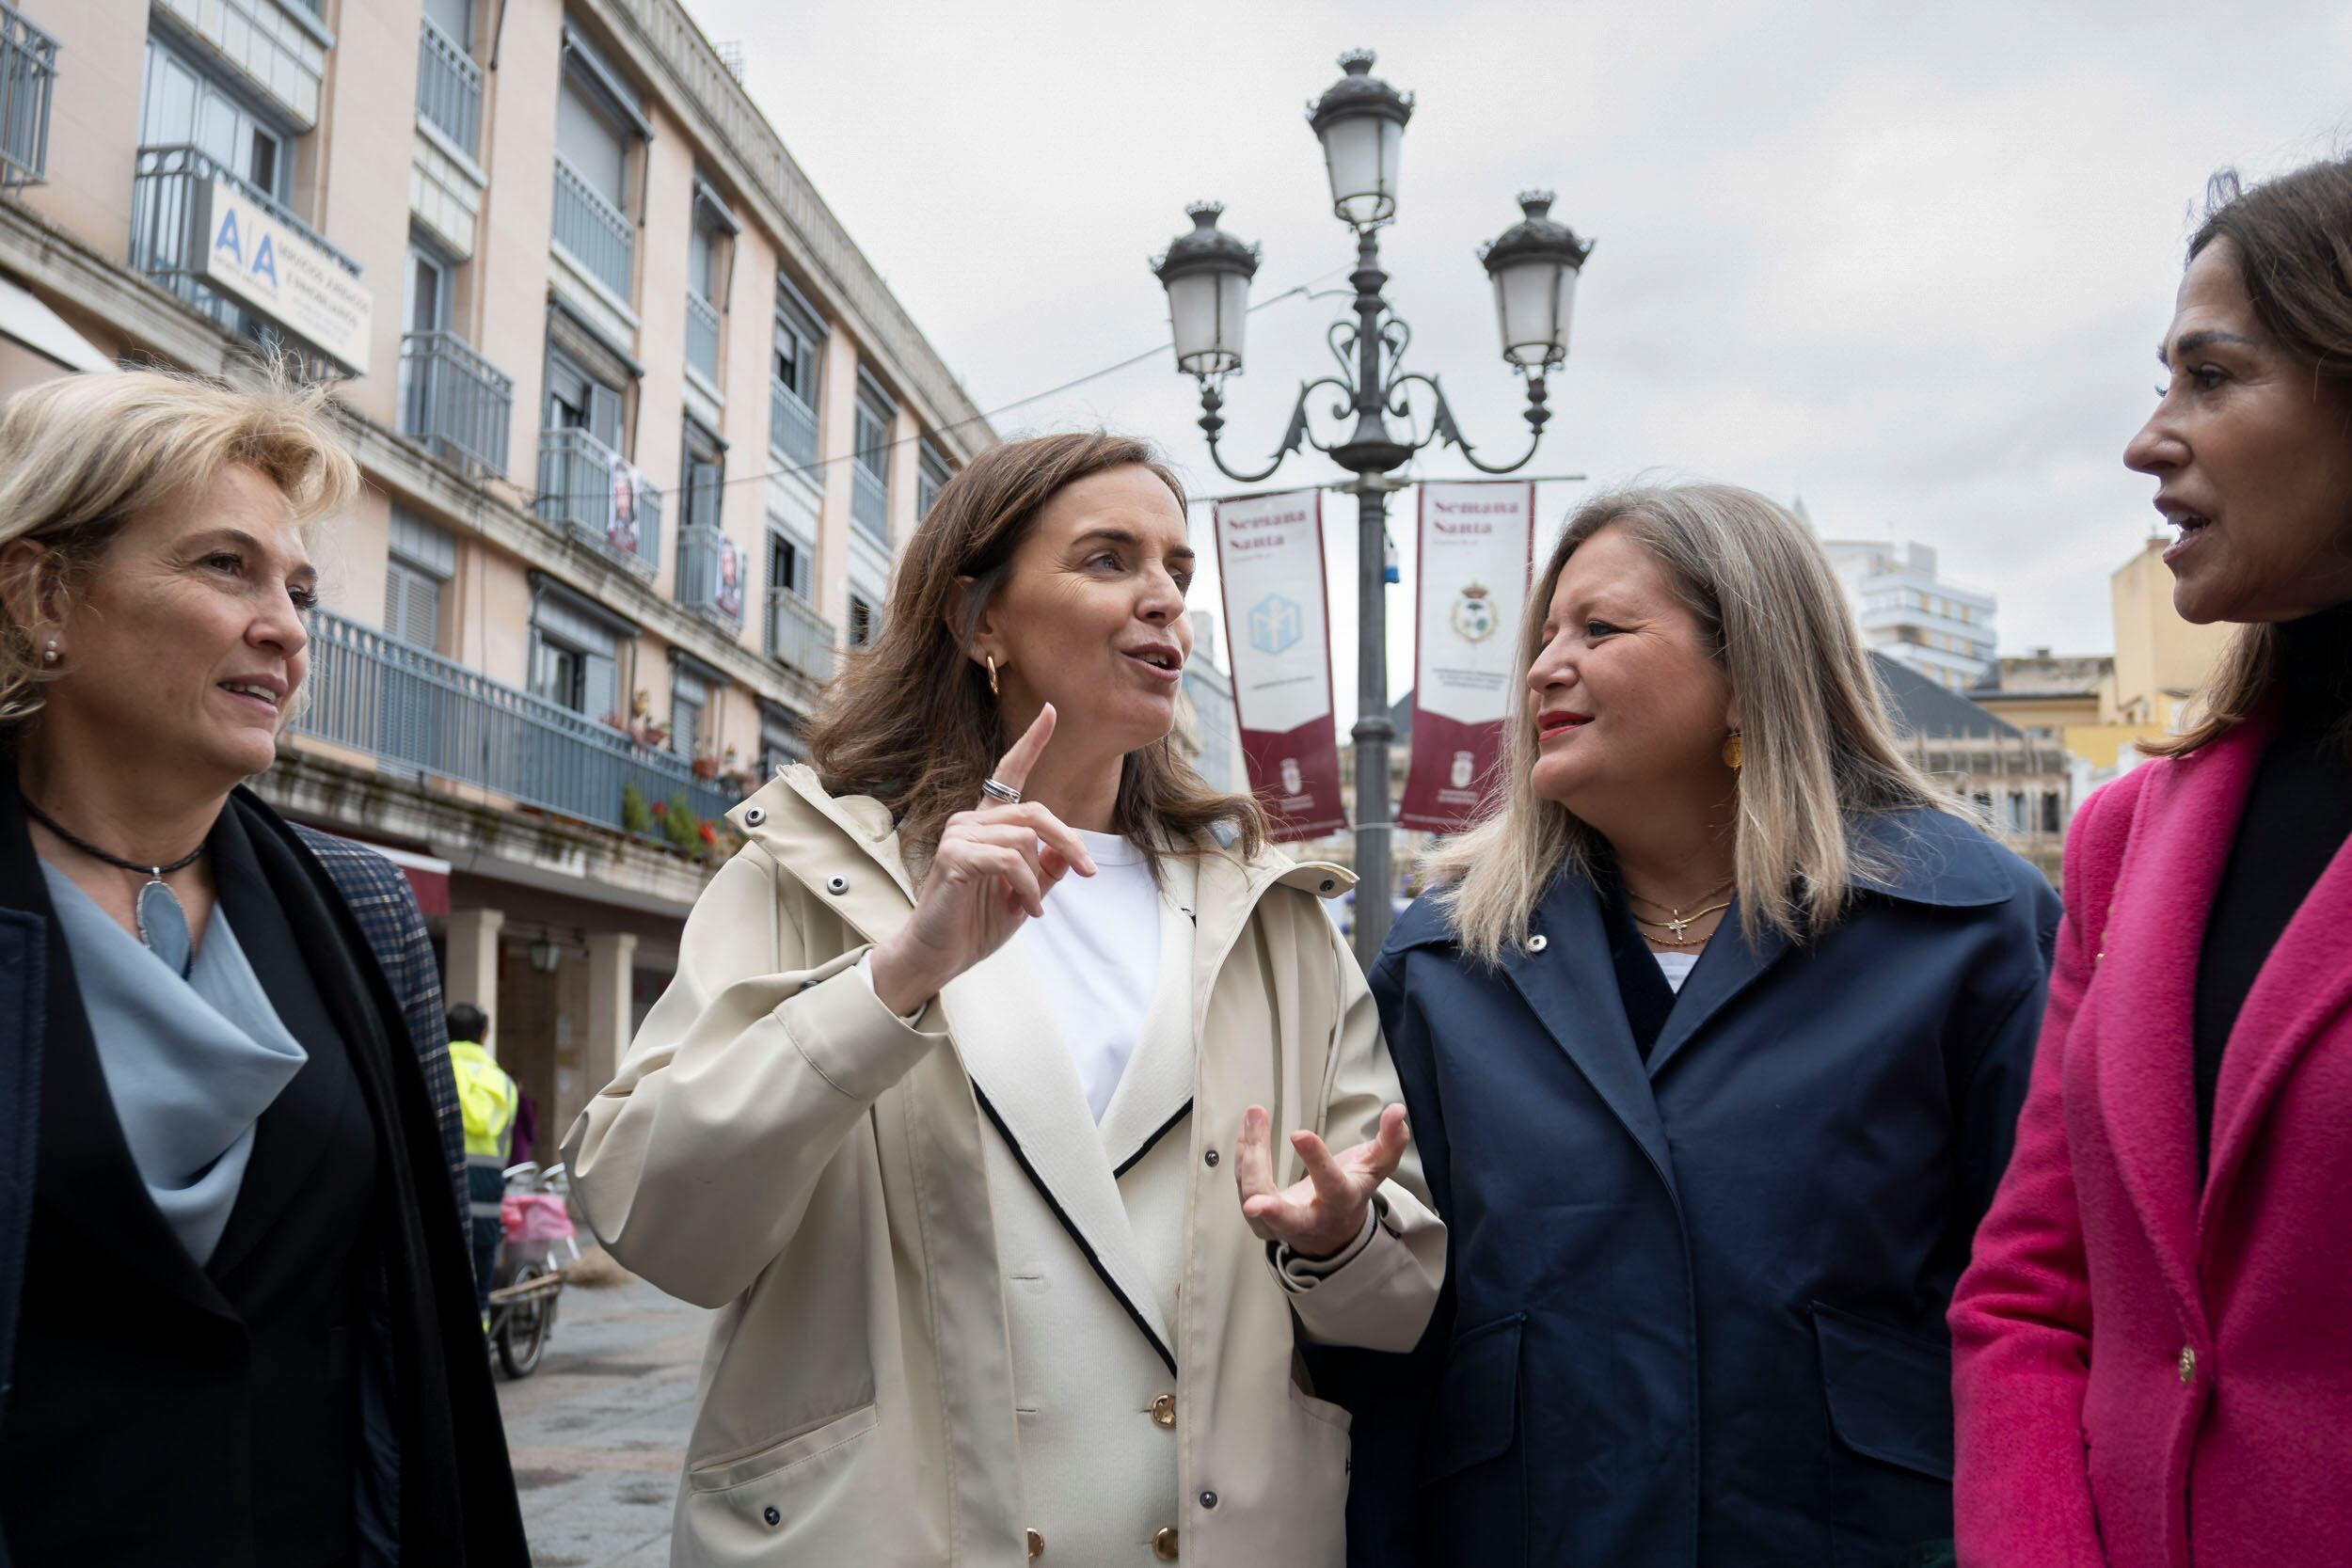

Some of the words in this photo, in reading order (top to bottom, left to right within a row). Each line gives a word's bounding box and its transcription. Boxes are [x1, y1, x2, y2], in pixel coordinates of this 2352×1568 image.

[215, 208, 242, 264] A
[251, 232, 278, 287] A
[1435, 501, 1518, 514] Semana
[1229, 510, 1307, 530] Semana
[1434, 520, 1492, 534] Santa
[1229, 535, 1284, 550] Santa
